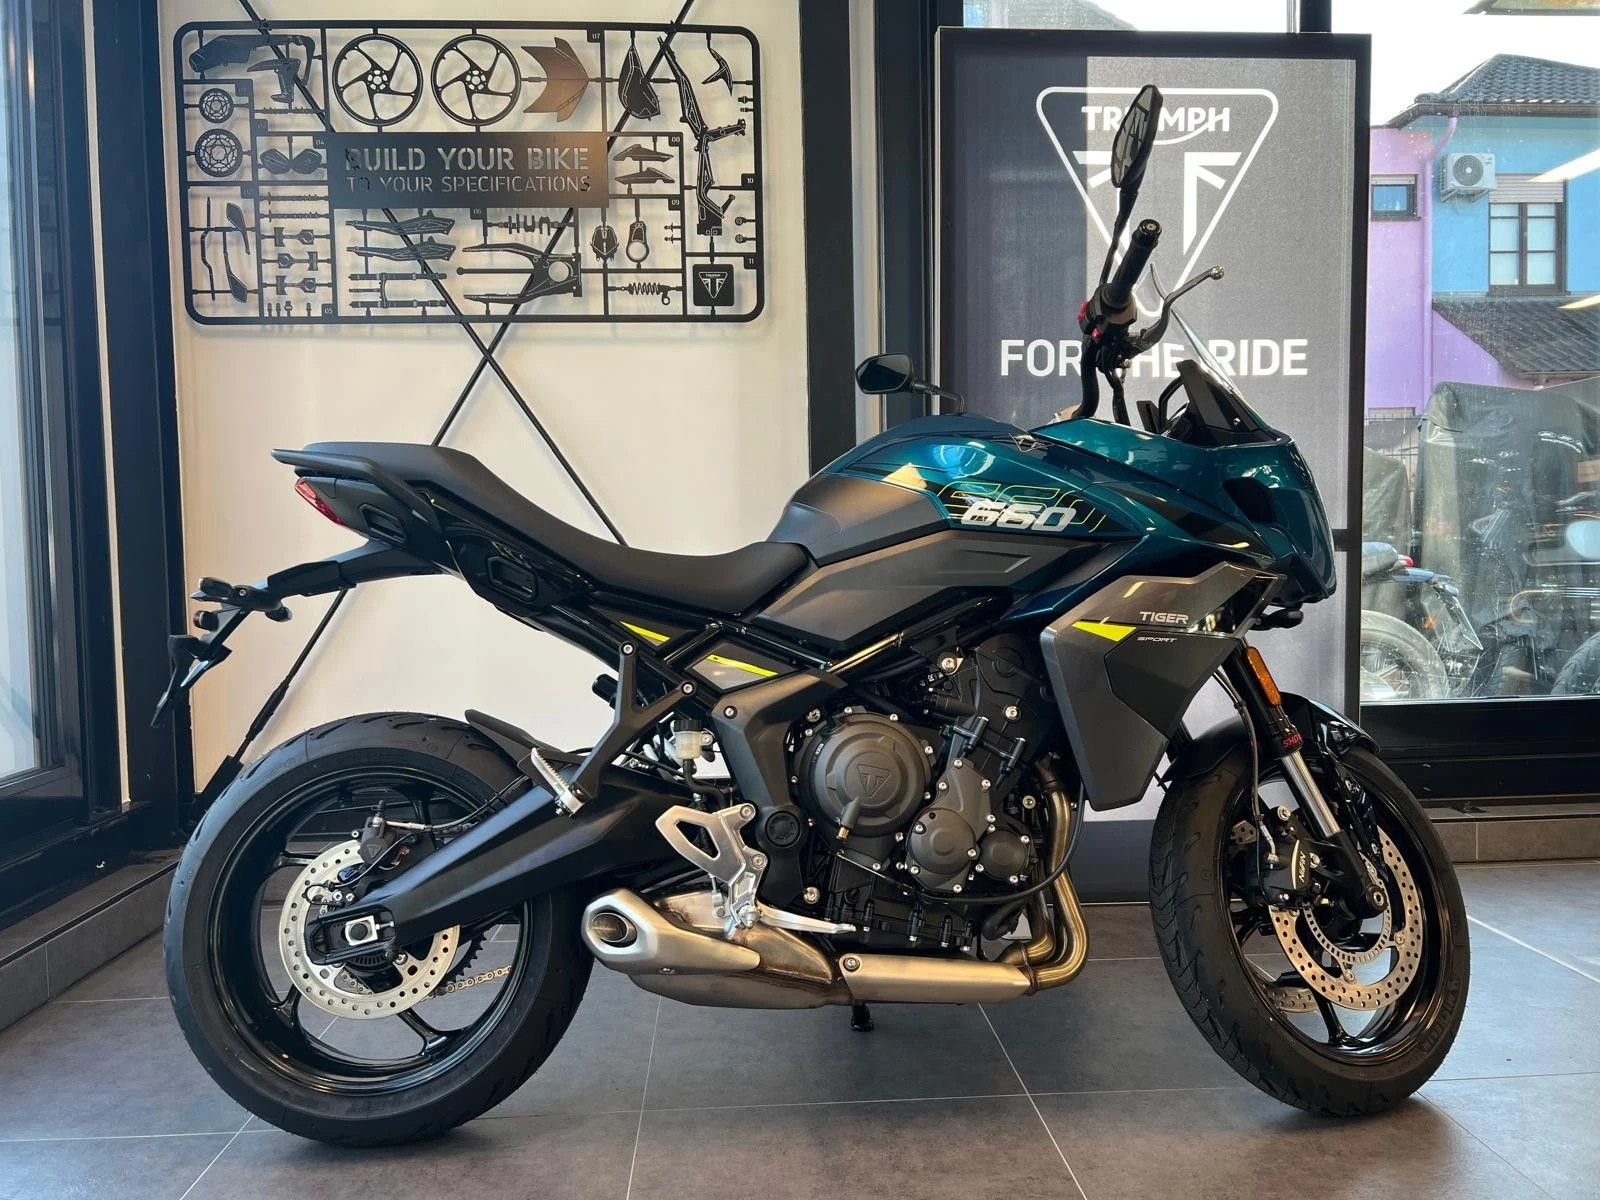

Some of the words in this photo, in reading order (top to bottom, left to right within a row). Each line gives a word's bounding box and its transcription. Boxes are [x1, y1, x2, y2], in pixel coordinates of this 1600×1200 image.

[1081, 106, 1231, 142] TRMPH
[345, 147, 426, 171] BUILD
[437, 147, 515, 171] YOUR
[527, 147, 589, 170] BIKE
[380, 176, 433, 193] YOUR
[441, 175, 591, 193] SPECIFICATIONS
[1000, 339, 1083, 377] FOR
[1126, 342, 1186, 378] HE
[1208, 338, 1309, 376] RIDE
[961, 500, 1077, 532] 660
[1139, 611, 1189, 625] TIGER
